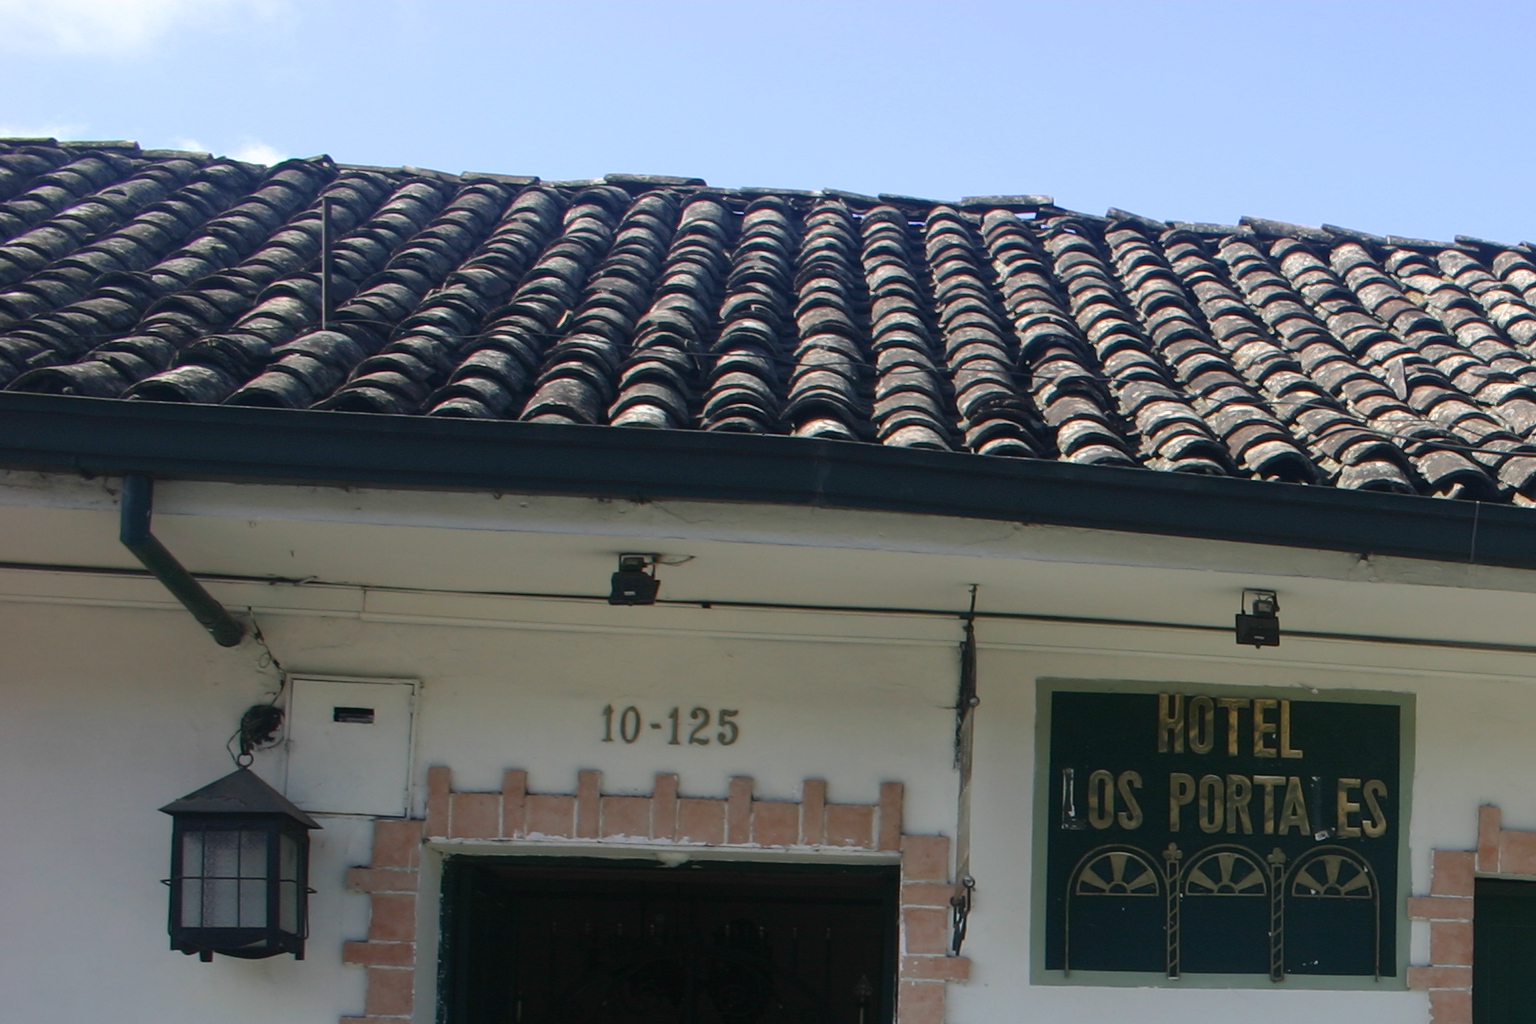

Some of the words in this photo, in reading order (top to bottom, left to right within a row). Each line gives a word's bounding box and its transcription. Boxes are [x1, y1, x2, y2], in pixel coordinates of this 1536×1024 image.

[601, 704, 740, 746] 10-125
[1157, 692, 1303, 759] HOTEL
[1061, 768, 1143, 831] LOS
